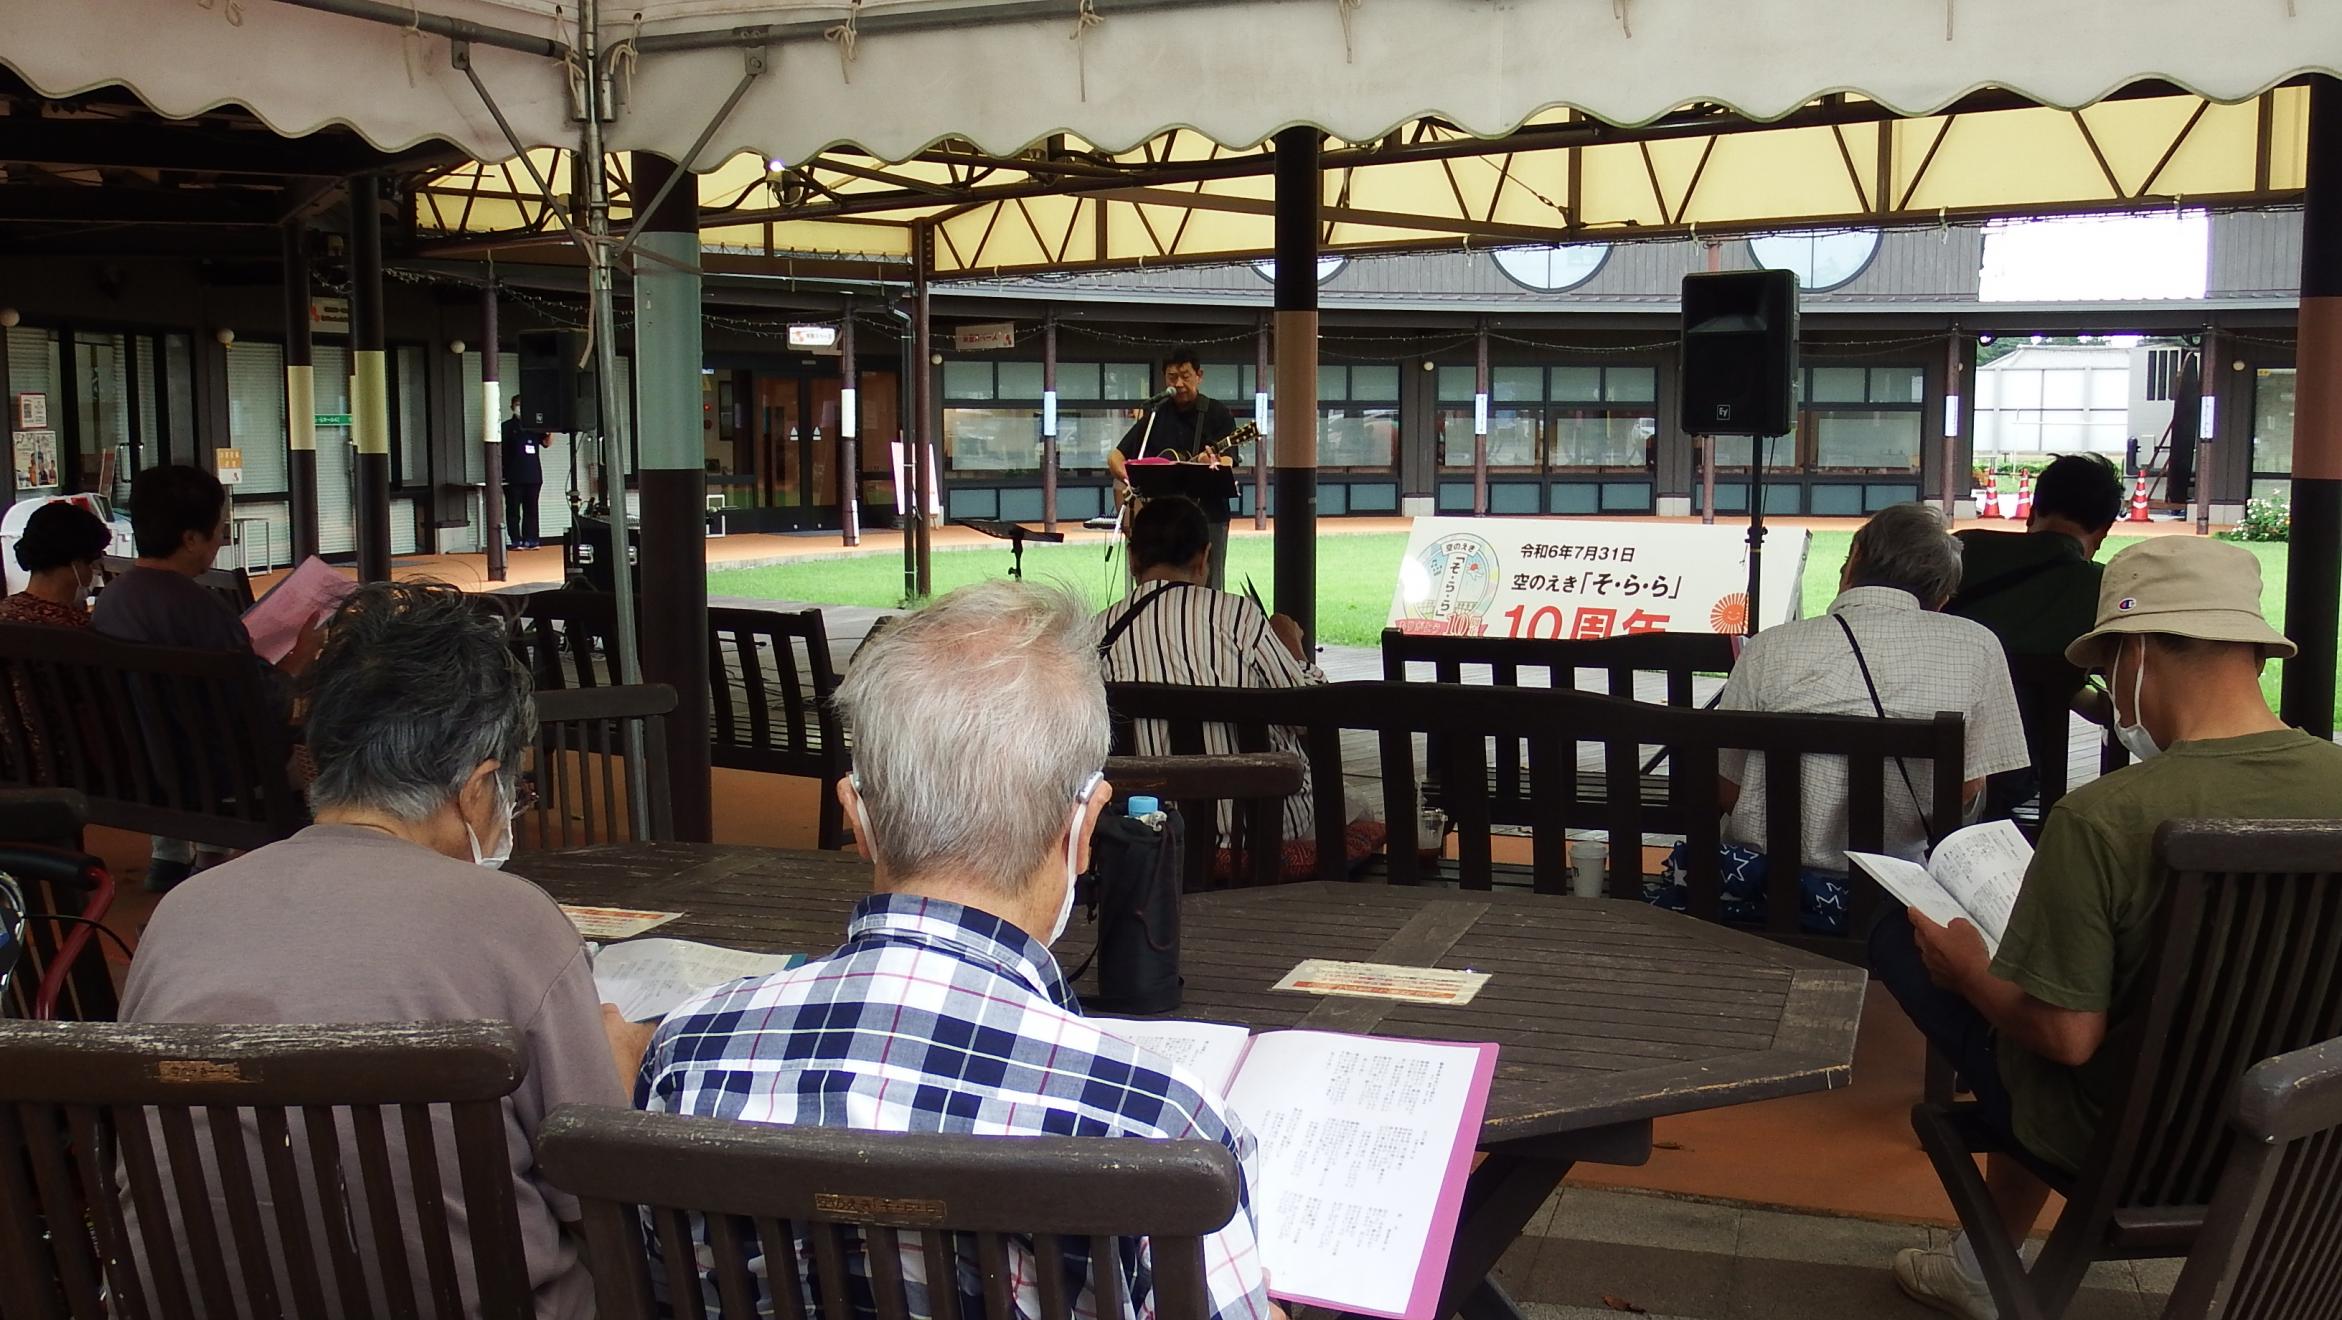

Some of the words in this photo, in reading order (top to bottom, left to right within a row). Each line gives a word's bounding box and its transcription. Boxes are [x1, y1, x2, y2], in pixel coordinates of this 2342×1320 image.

[1520, 543, 1636, 562] 令和6年7月31日
[1511, 571, 1682, 600] 空のえき「そ・ら・ら」
